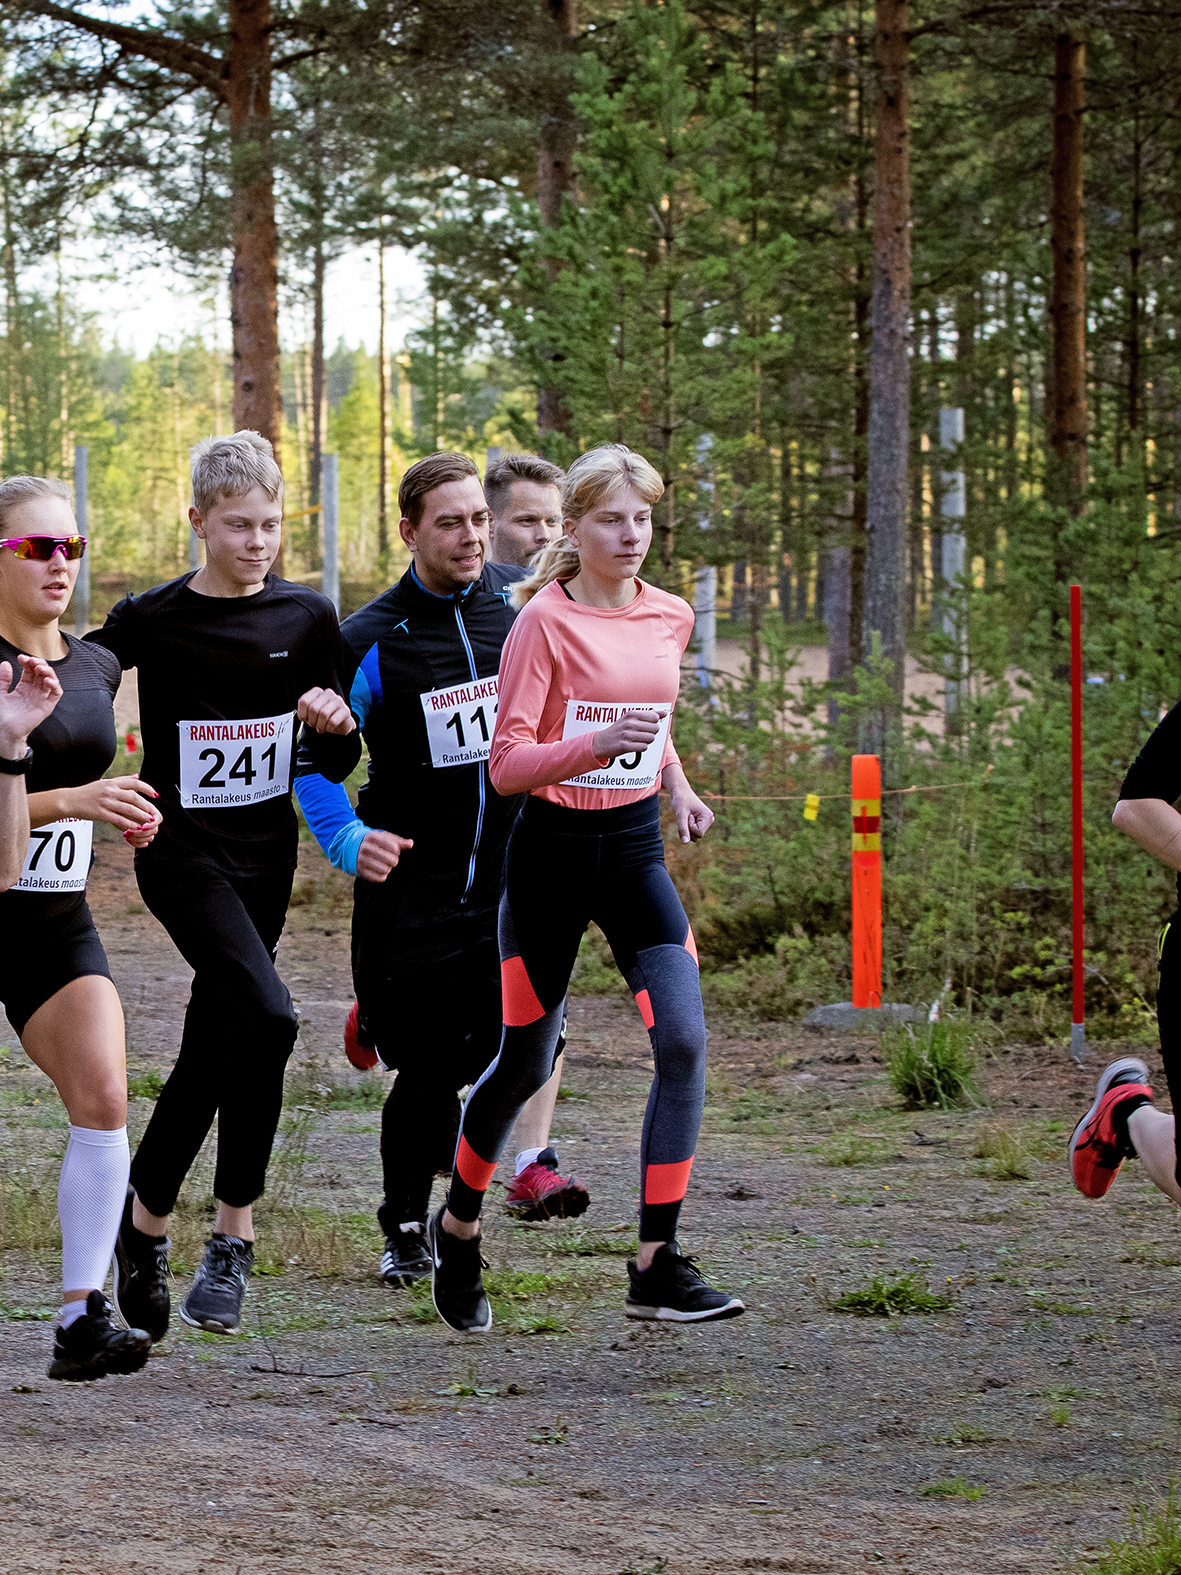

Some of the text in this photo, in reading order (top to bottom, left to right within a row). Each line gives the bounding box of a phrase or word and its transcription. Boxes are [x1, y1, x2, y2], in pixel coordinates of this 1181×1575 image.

[446, 702, 499, 748] 11
[198, 742, 277, 788] 241
[442, 749, 490, 764] Rantalake
[567, 775, 625, 786] antalakeus
[191, 785, 281, 804] Rantalakeus maasto
[28, 830, 76, 873] 70
[15, 877, 60, 889] talakeus
